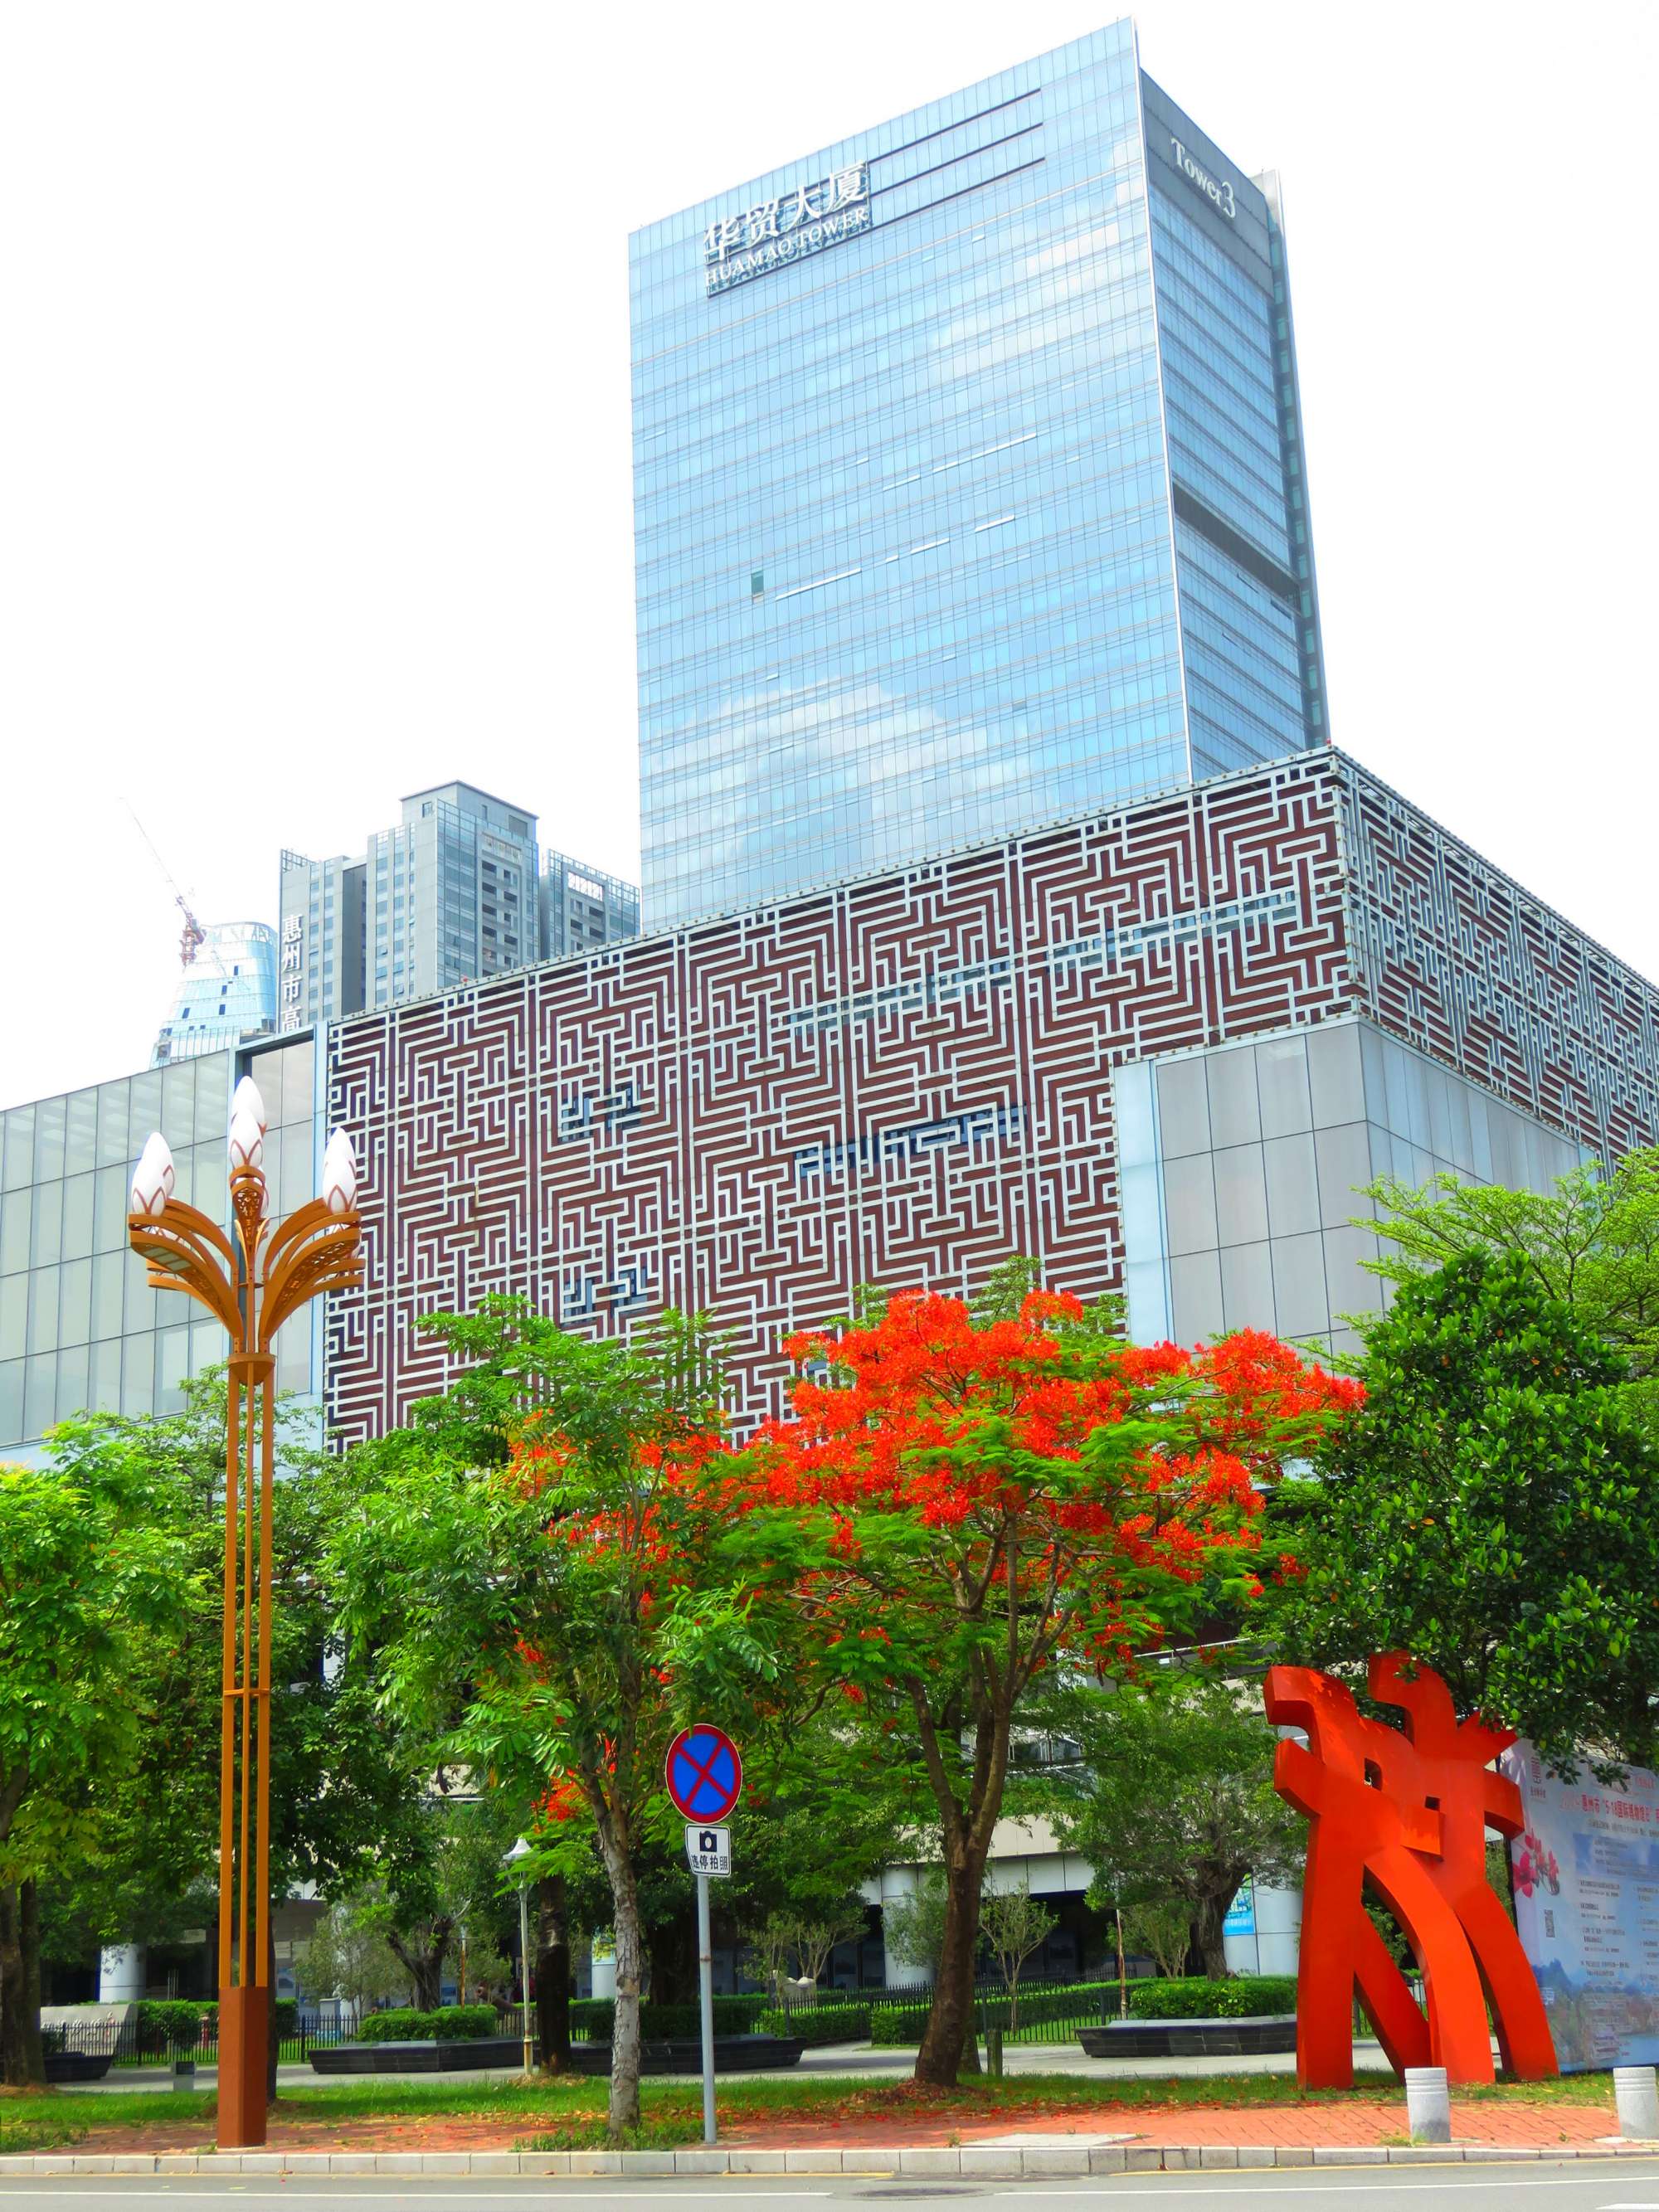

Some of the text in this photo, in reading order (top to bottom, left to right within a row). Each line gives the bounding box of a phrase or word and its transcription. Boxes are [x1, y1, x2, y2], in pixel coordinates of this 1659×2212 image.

[704, 162, 868, 261] 华贸大厦
[1170, 137, 1236, 219] Tower 3
[705, 207, 868, 285] HUAMAO TOWER
[281, 914, 304, 1033] 惠州市高
[691, 1854, 728, 1871] 违停拍照
